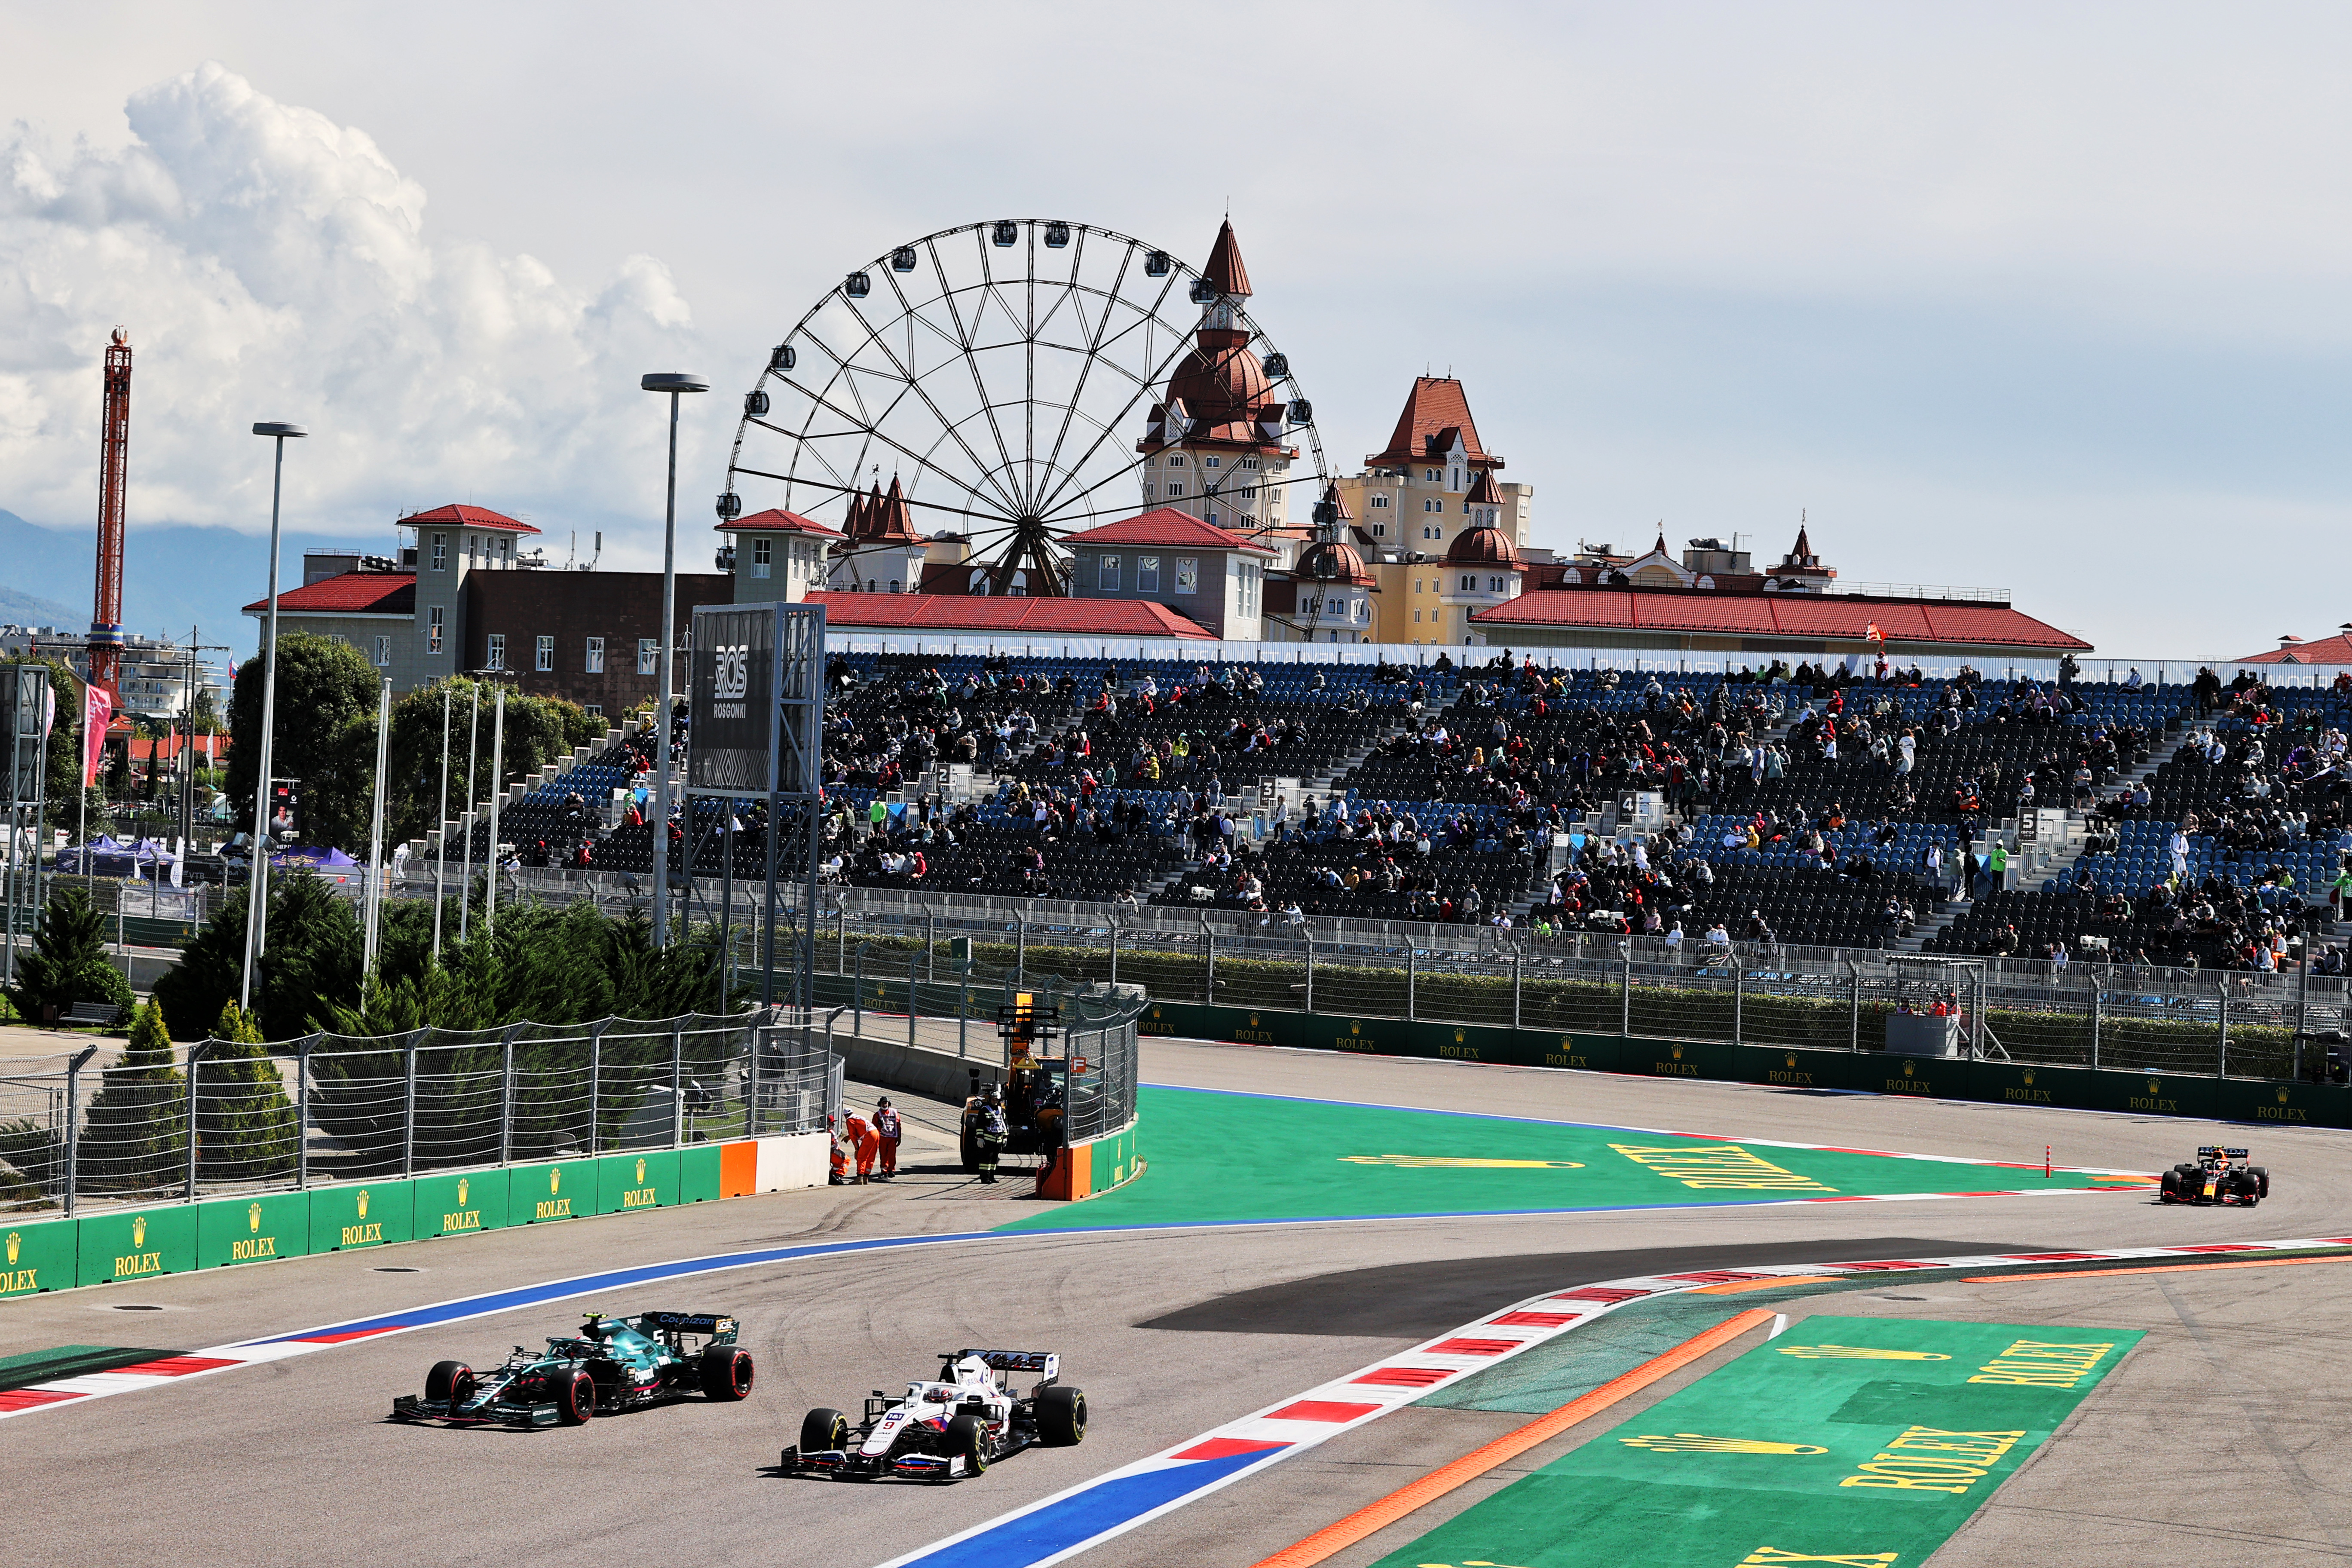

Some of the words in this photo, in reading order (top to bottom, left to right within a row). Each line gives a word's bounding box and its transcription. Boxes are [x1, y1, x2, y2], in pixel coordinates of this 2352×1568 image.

[714, 645, 748, 698] ROS
[714, 703, 746, 719] ROSGONKI
[939, 769, 947, 781] 2
[1263, 782, 1272, 796] 3
[1623, 797, 1633, 811] 4
[2023, 814, 2034, 828] 5
[953, 1006, 986, 1019] RLEX
[1139, 1021, 1174, 1034] ROLEX
[1235, 1029, 1273, 1042] ROLEX
[1336, 1038, 1375, 1050] ROLEX
[1439, 1046, 1479, 1058] ROLEX
[1074, 1059, 1084, 1070] F
[1546, 1054, 1587, 1067] ROLEX
[1656, 1062, 1698, 1075] ROLEX
[1769, 1070, 1813, 1084] ROLEX
[1886, 1079, 1930, 1093] ROLEX
[2005, 1088, 2052, 1102] ROLEX
[2129, 1096, 2177, 1111] ROLEX
[2257, 1106, 2307, 1121] ROLEX
[1607, 1144, 1841, 1192] ROLEX
[624, 1188, 655, 1207] ROLEX
[536, 1198, 571, 1219] ROLEX
[443, 1210, 481, 1231] ROLEX
[342, 1223, 382, 1245] ROLEX
[233, 1237, 276, 1260] ROLEX
[115, 1252, 161, 1277] ROLEX
[0, 1269, 37, 1293] OLEX
[627, 1317, 642, 1326] PERONI
[717, 1321, 732, 1330] JCB
[653, 1329, 664, 1345] 5
[1966, 1340, 2115, 1388] ROLEX
[986, 1367, 988, 1383] 9
[1839, 1426, 2026, 1494] ROLEX
